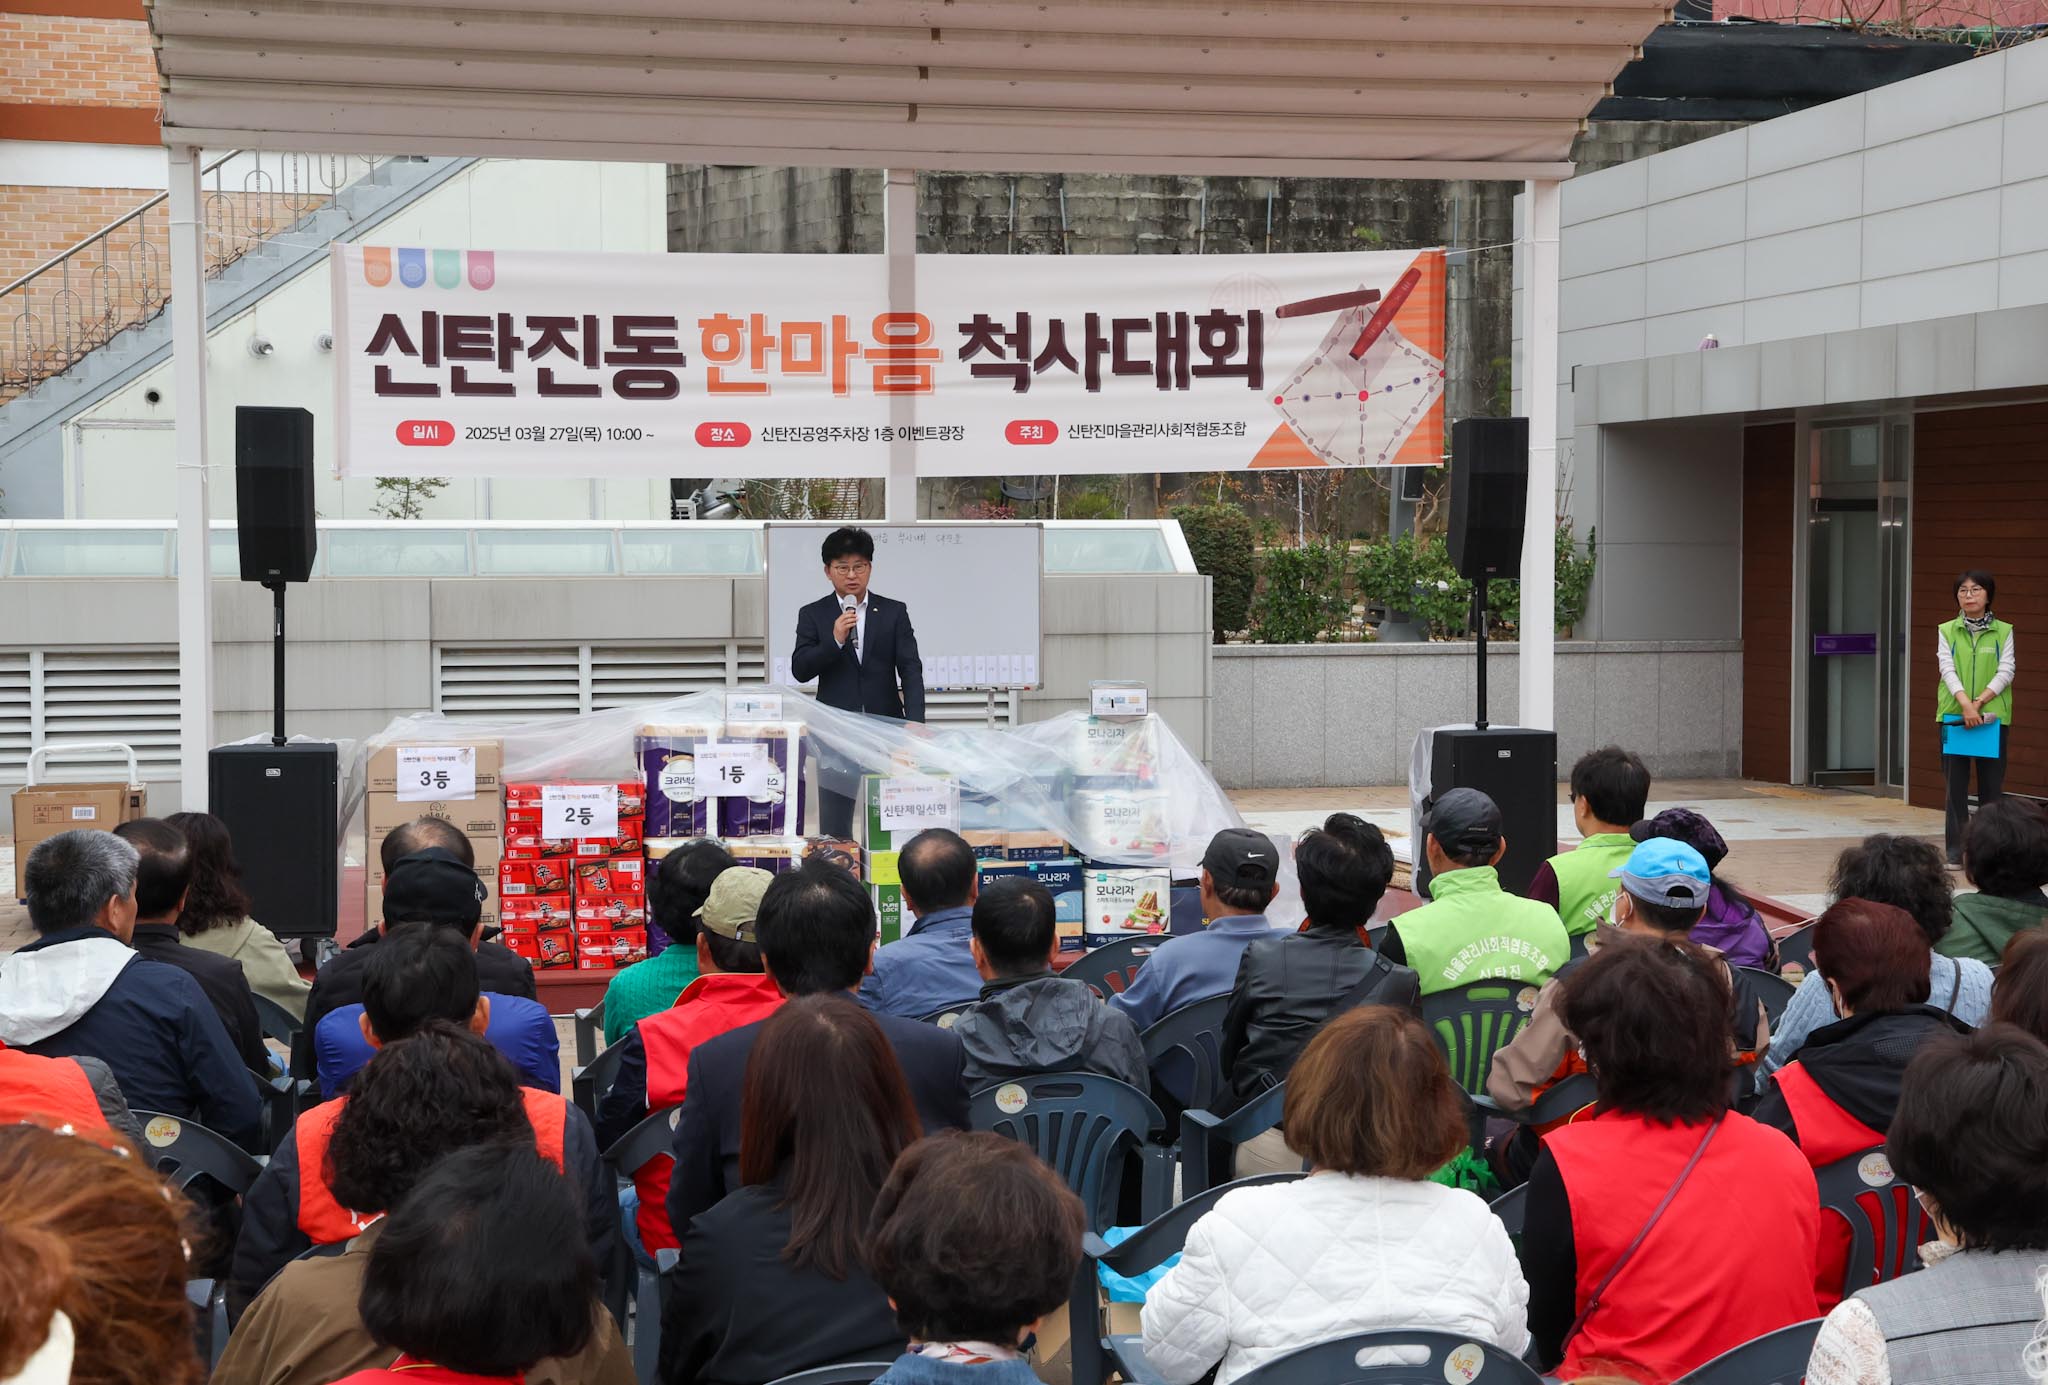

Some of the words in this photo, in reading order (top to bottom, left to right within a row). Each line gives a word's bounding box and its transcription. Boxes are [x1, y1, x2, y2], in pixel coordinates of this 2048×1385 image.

[364, 310, 687, 400] 신탄진동
[698, 312, 944, 396] 한마음
[958, 308, 1264, 393] 척사대회
[412, 424, 439, 440] 일시
[465, 426, 511, 441] 2025년
[515, 426, 546, 442] 03월
[549, 427, 602, 442] 27일(목)
[606, 428, 642, 441] 10:00
[710, 427, 736, 442] 장소
[760, 426, 869, 442] 신탄진공영주차장
[874, 427, 895, 441] 1층
[898, 425, 965, 441] 이벤트광장
[1020, 425, 1044, 440] 주최
[1067, 421, 1248, 439] 신탄진마을관리사회적협동조합
[420, 770, 451, 789] 3등
[719, 765, 745, 784] 1등
[565, 807, 594, 825] 2등
[1037, 872, 1071, 883] 모나리자
[1096, 885, 1135, 895] 모나리자
[1584, 889, 1617, 920] 마을관리
[1442, 936, 1550, 981] 마을관리사회적협동조합
